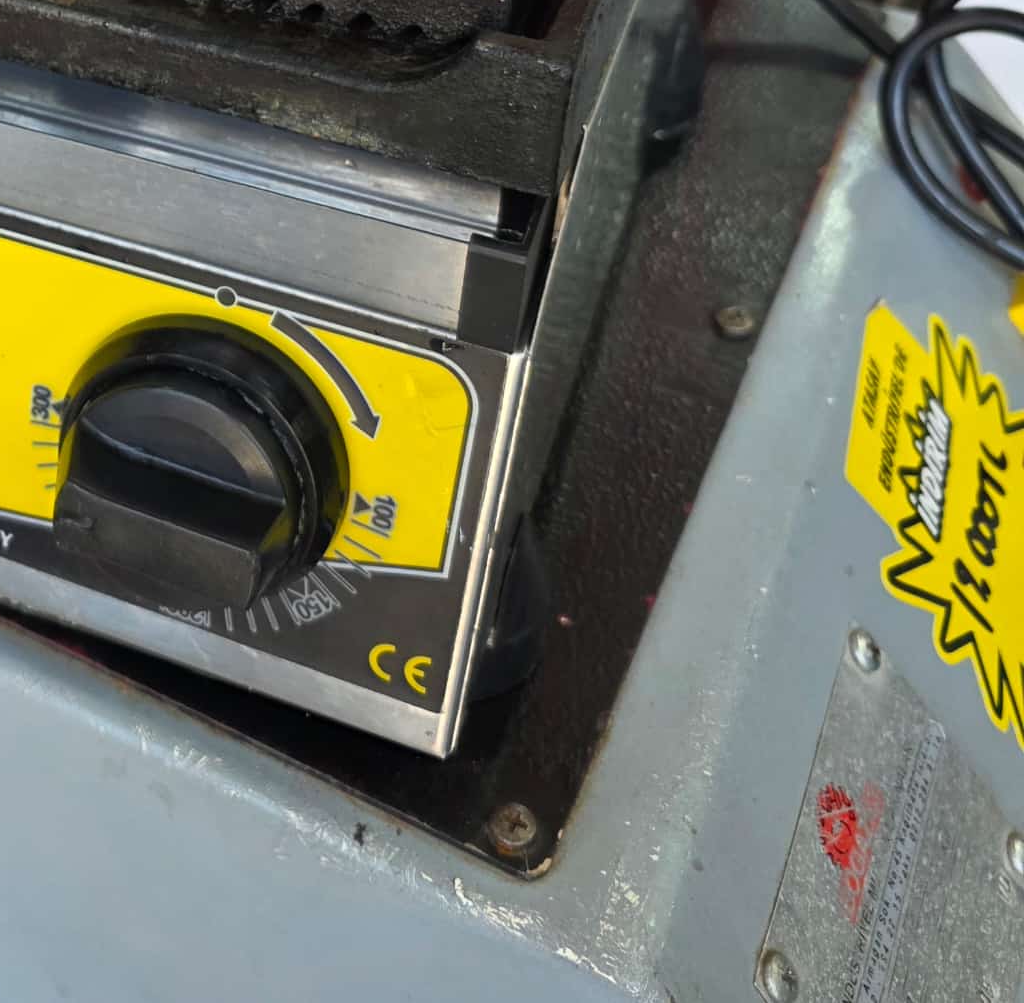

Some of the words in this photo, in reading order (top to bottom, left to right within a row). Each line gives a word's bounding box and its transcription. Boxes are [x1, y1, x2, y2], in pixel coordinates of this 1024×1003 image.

[32, 384, 52, 420] 300
[371, 495, 396, 530] 100
[294, 591, 333, 621] 150
[368, 644, 432, 695] CE
